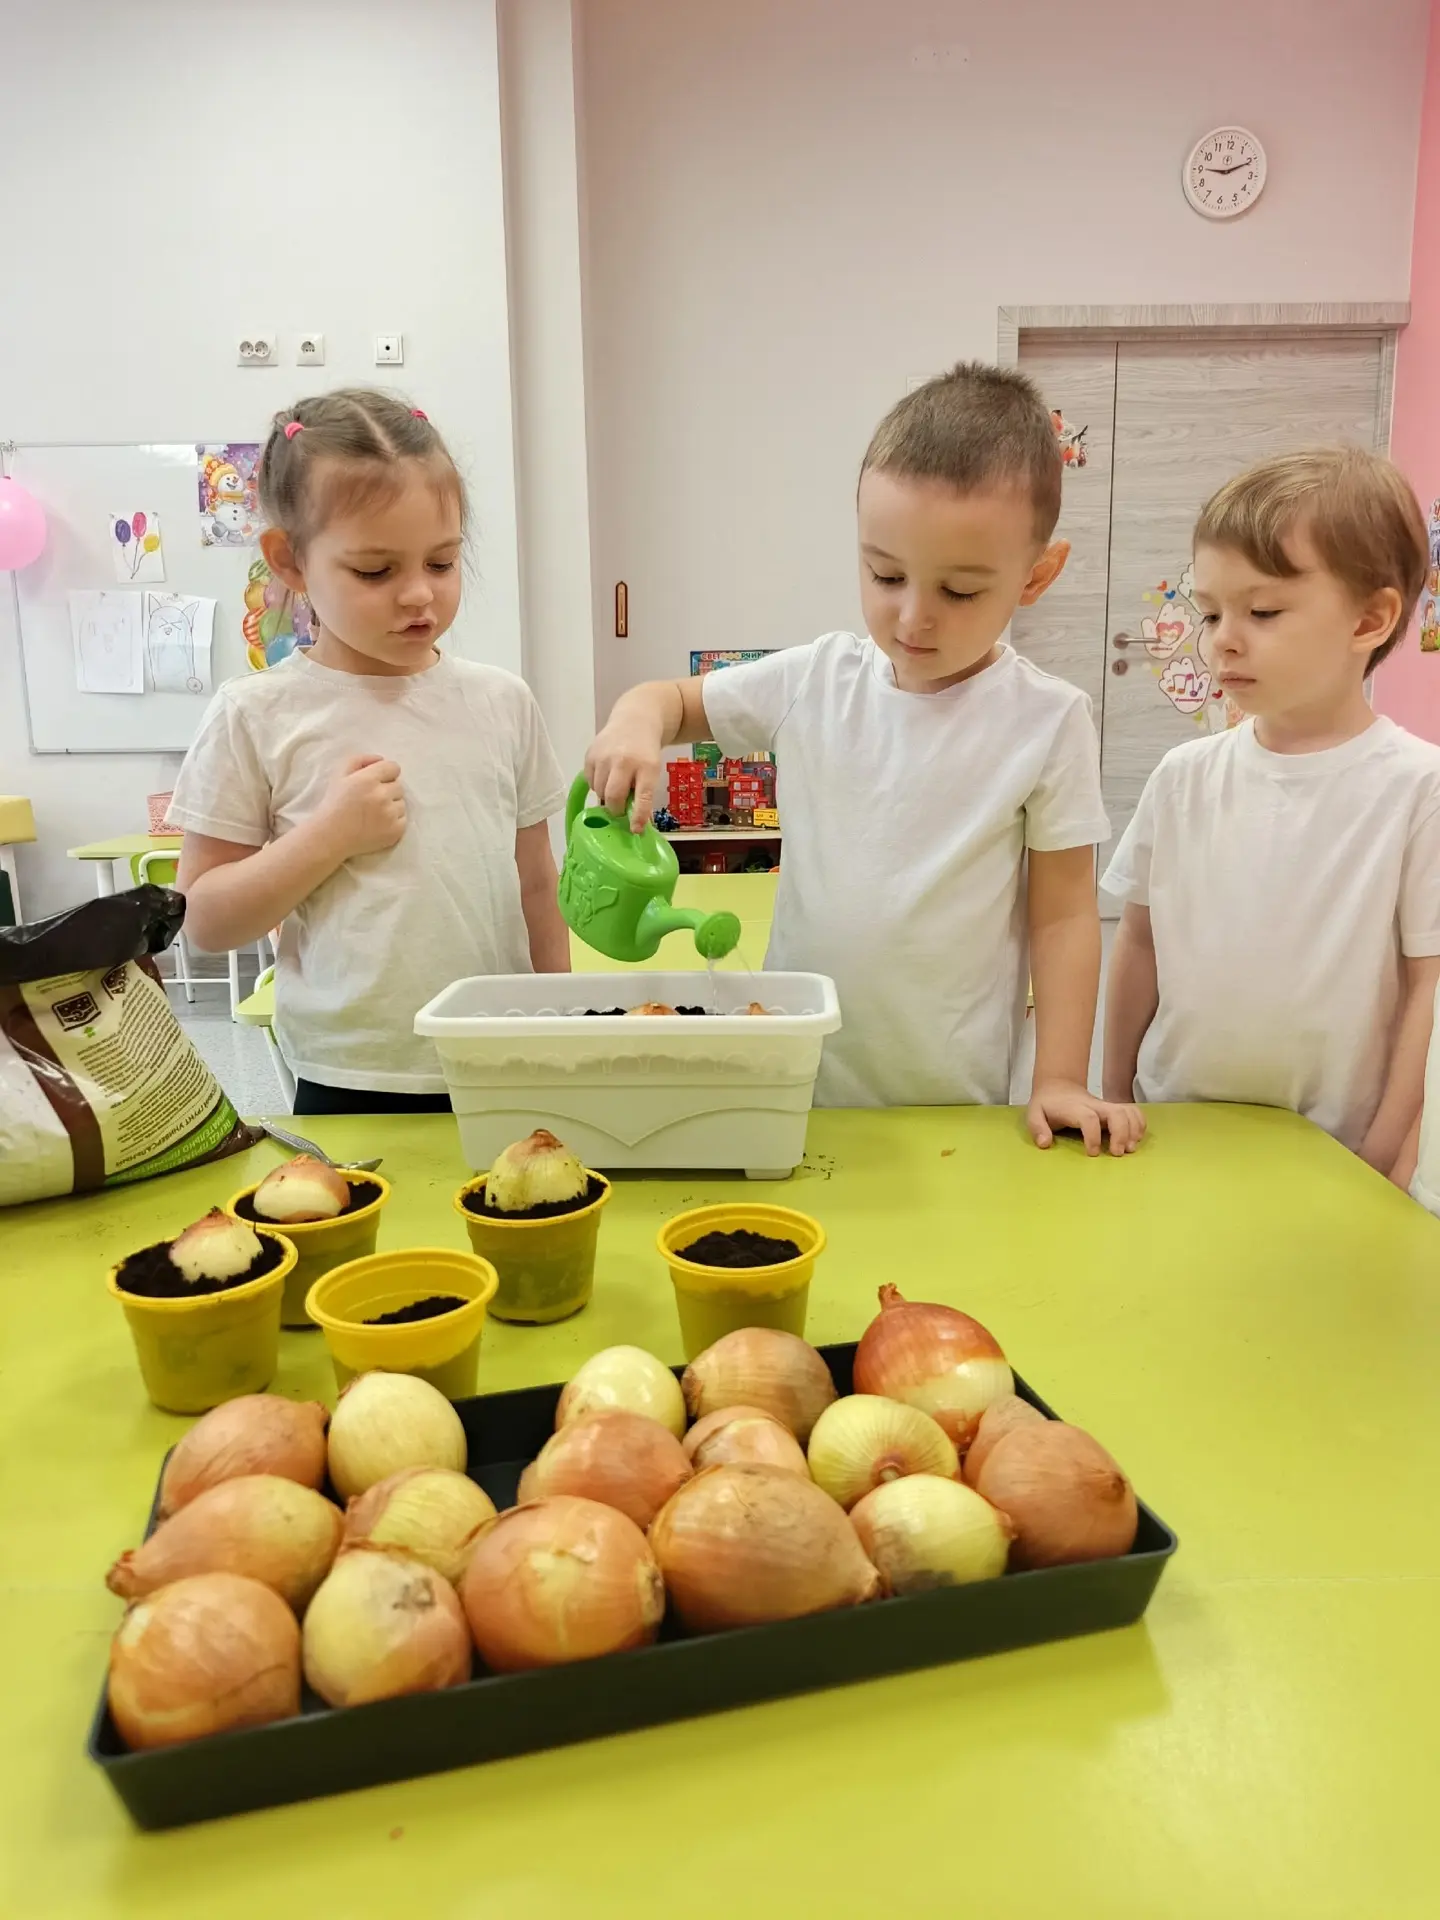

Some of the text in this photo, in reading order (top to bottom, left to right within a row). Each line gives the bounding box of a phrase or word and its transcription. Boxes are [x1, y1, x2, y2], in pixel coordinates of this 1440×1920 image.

[1214, 142, 1222, 153] 11
[1227, 140, 1235, 150] 12
[1240, 145, 1245, 155] 1
[1204, 152, 1213, 162] 10
[1246, 157, 1252, 166] 2
[1198, 164, 1204, 174] 9
[1247, 171, 1253, 180] 3
[1199, 178, 1205, 188] 8
[1240, 184, 1247, 192] 4
[1206, 190, 1212, 199] 7
[1231, 193, 1238, 202] 5
[1216, 195, 1223, 204] 6
